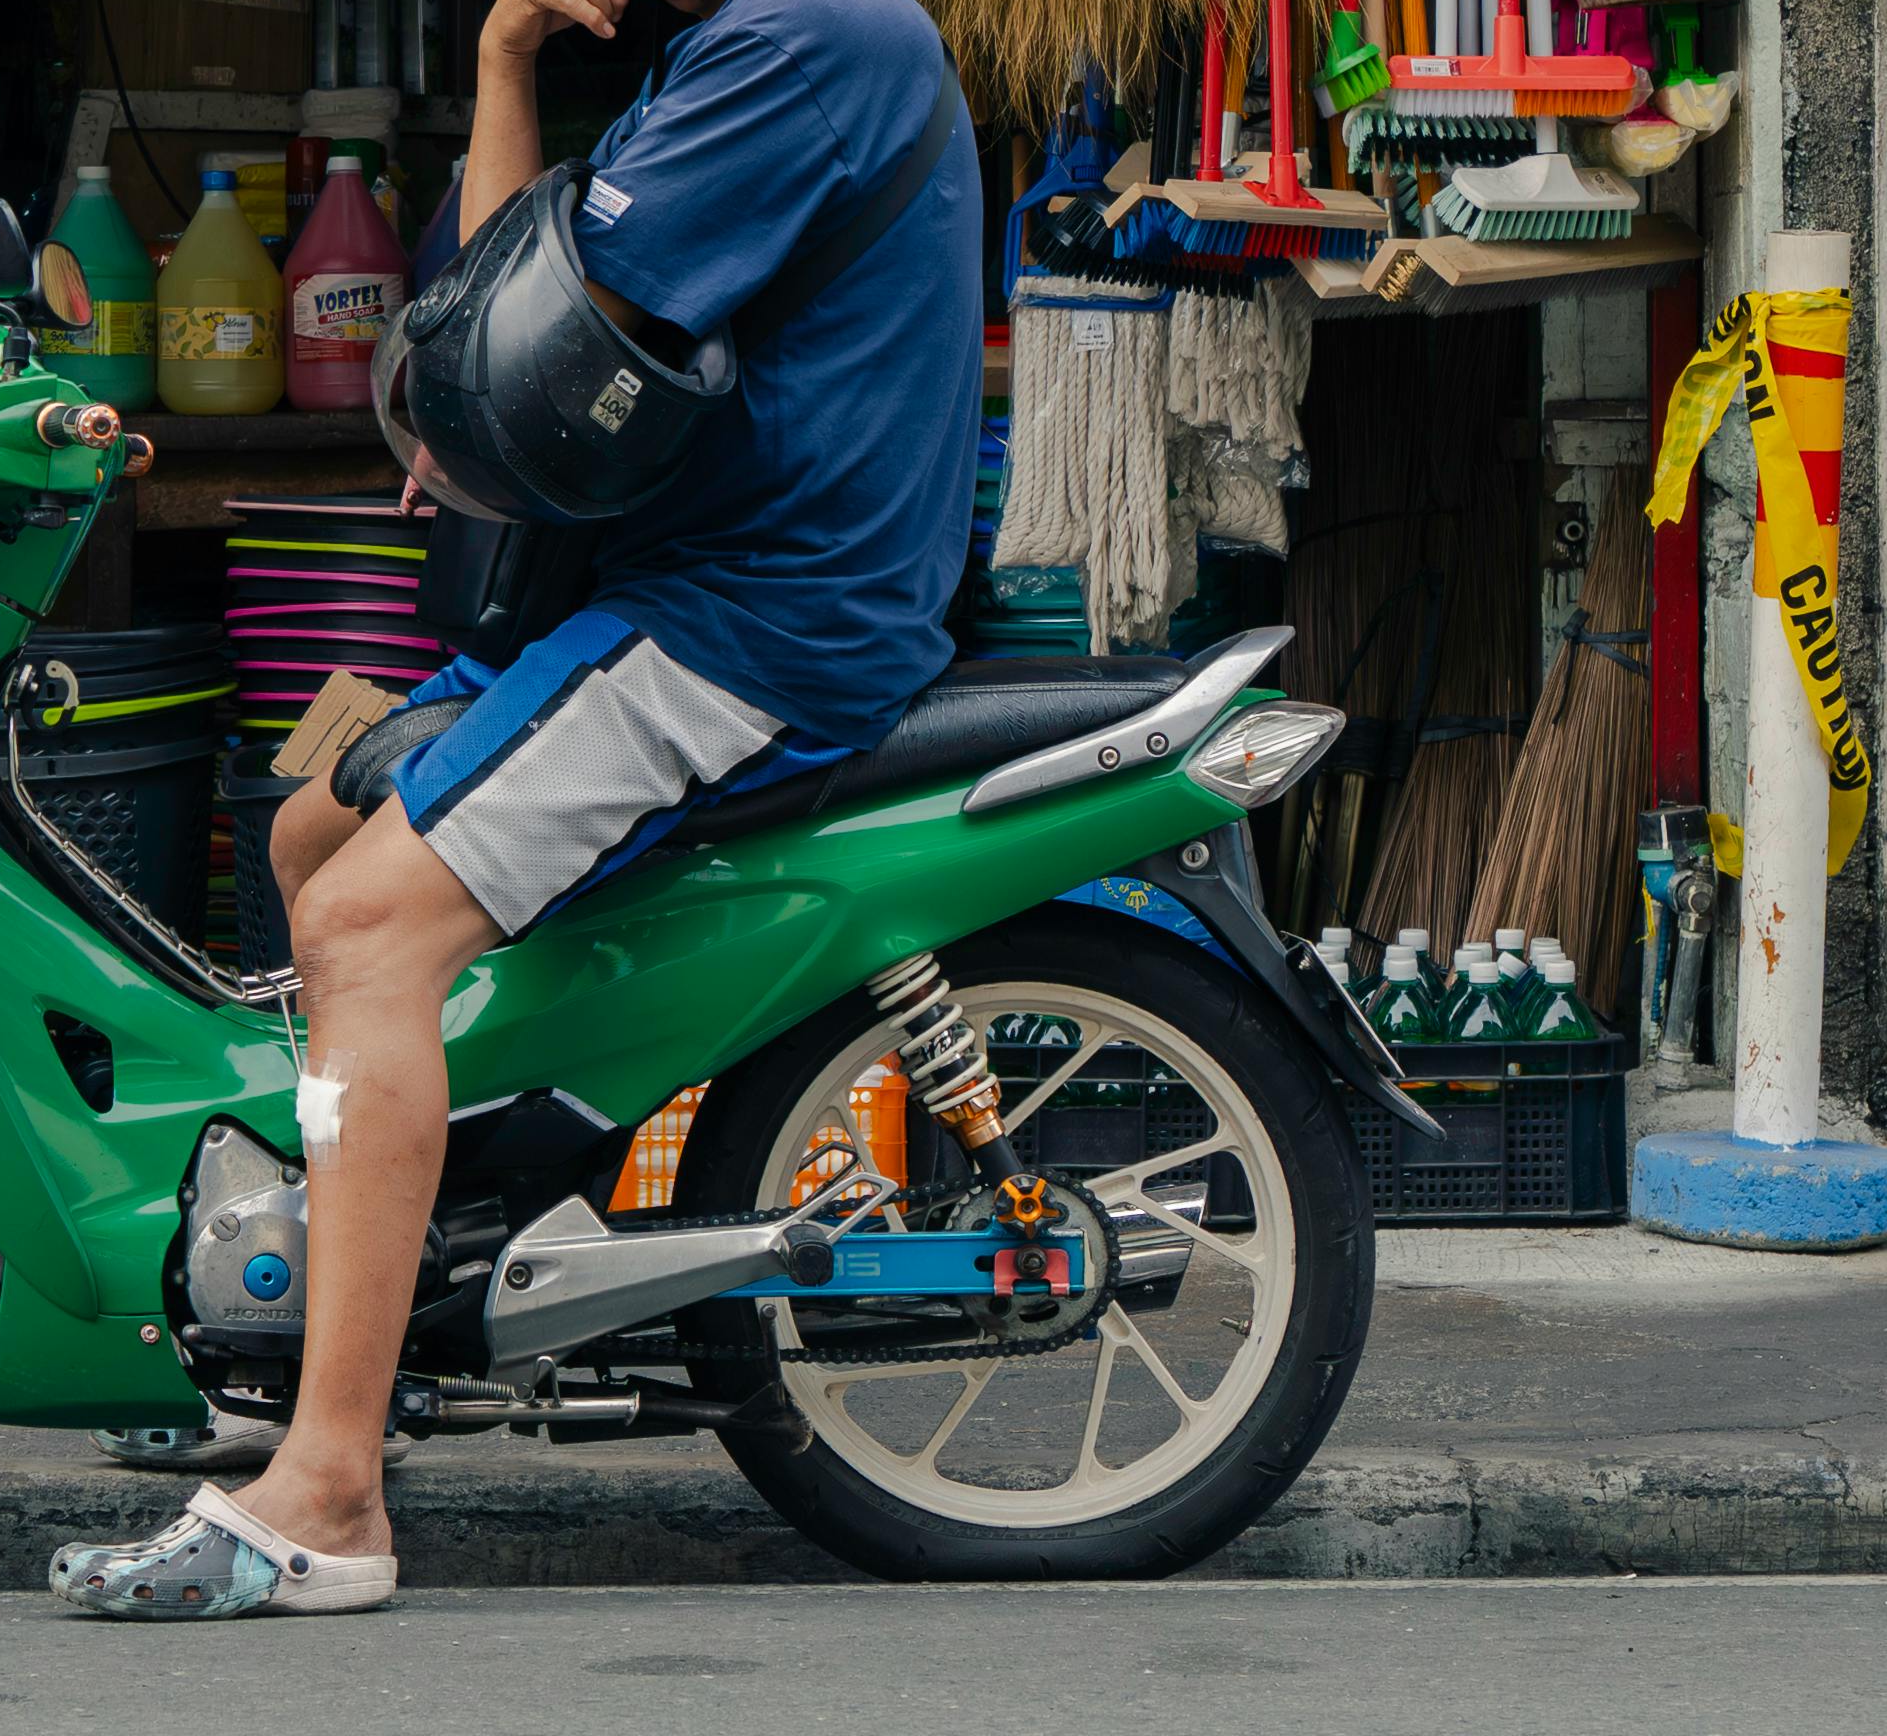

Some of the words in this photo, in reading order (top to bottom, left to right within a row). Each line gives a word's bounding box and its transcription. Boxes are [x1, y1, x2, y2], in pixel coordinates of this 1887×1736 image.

[314, 283, 383, 313] VORTEX
[327, 311, 351, 322] HAND
[353, 307, 376, 318] SOAP
[598, 395, 628, 421] DOT
[223, 1308, 306, 1321] HONDA
